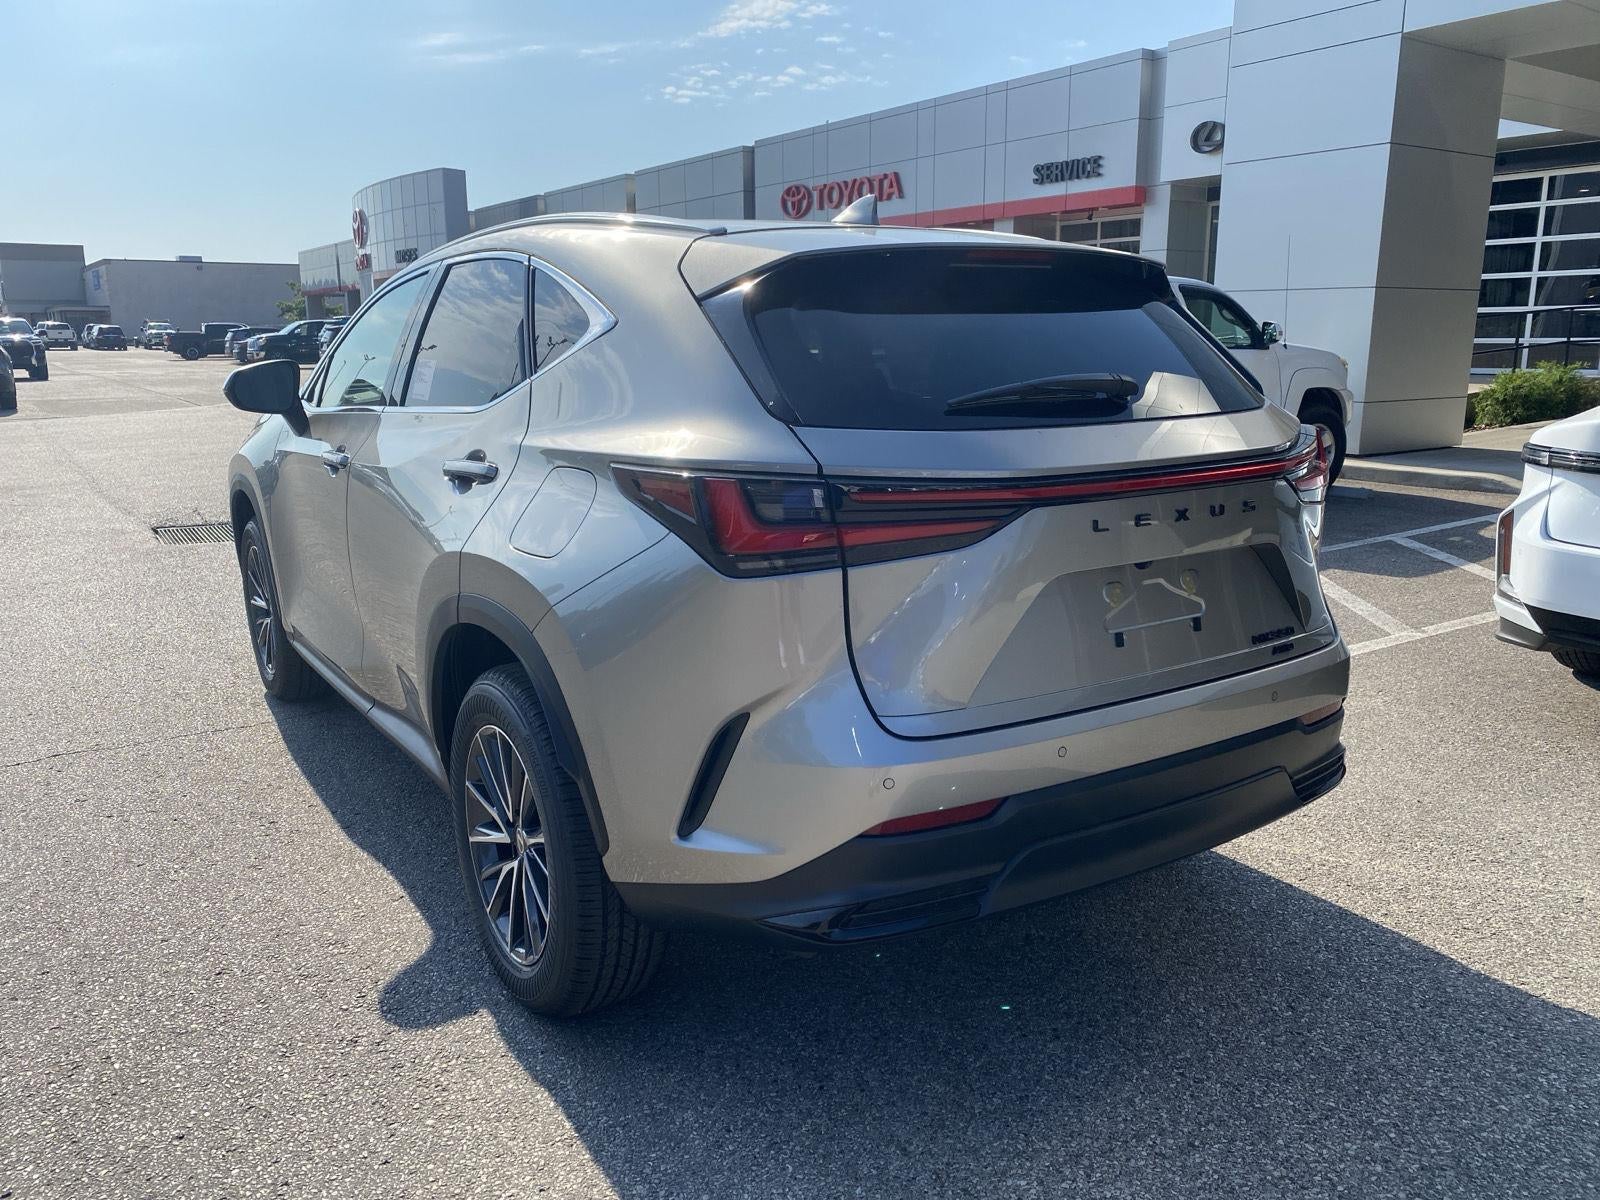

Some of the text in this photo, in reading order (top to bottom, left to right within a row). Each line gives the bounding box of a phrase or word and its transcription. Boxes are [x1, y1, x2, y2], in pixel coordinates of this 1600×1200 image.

[1032, 155, 1104, 185] SERVICE
[812, 171, 904, 210] TOYOTA
[1092, 500, 1257, 533] LEXUS
